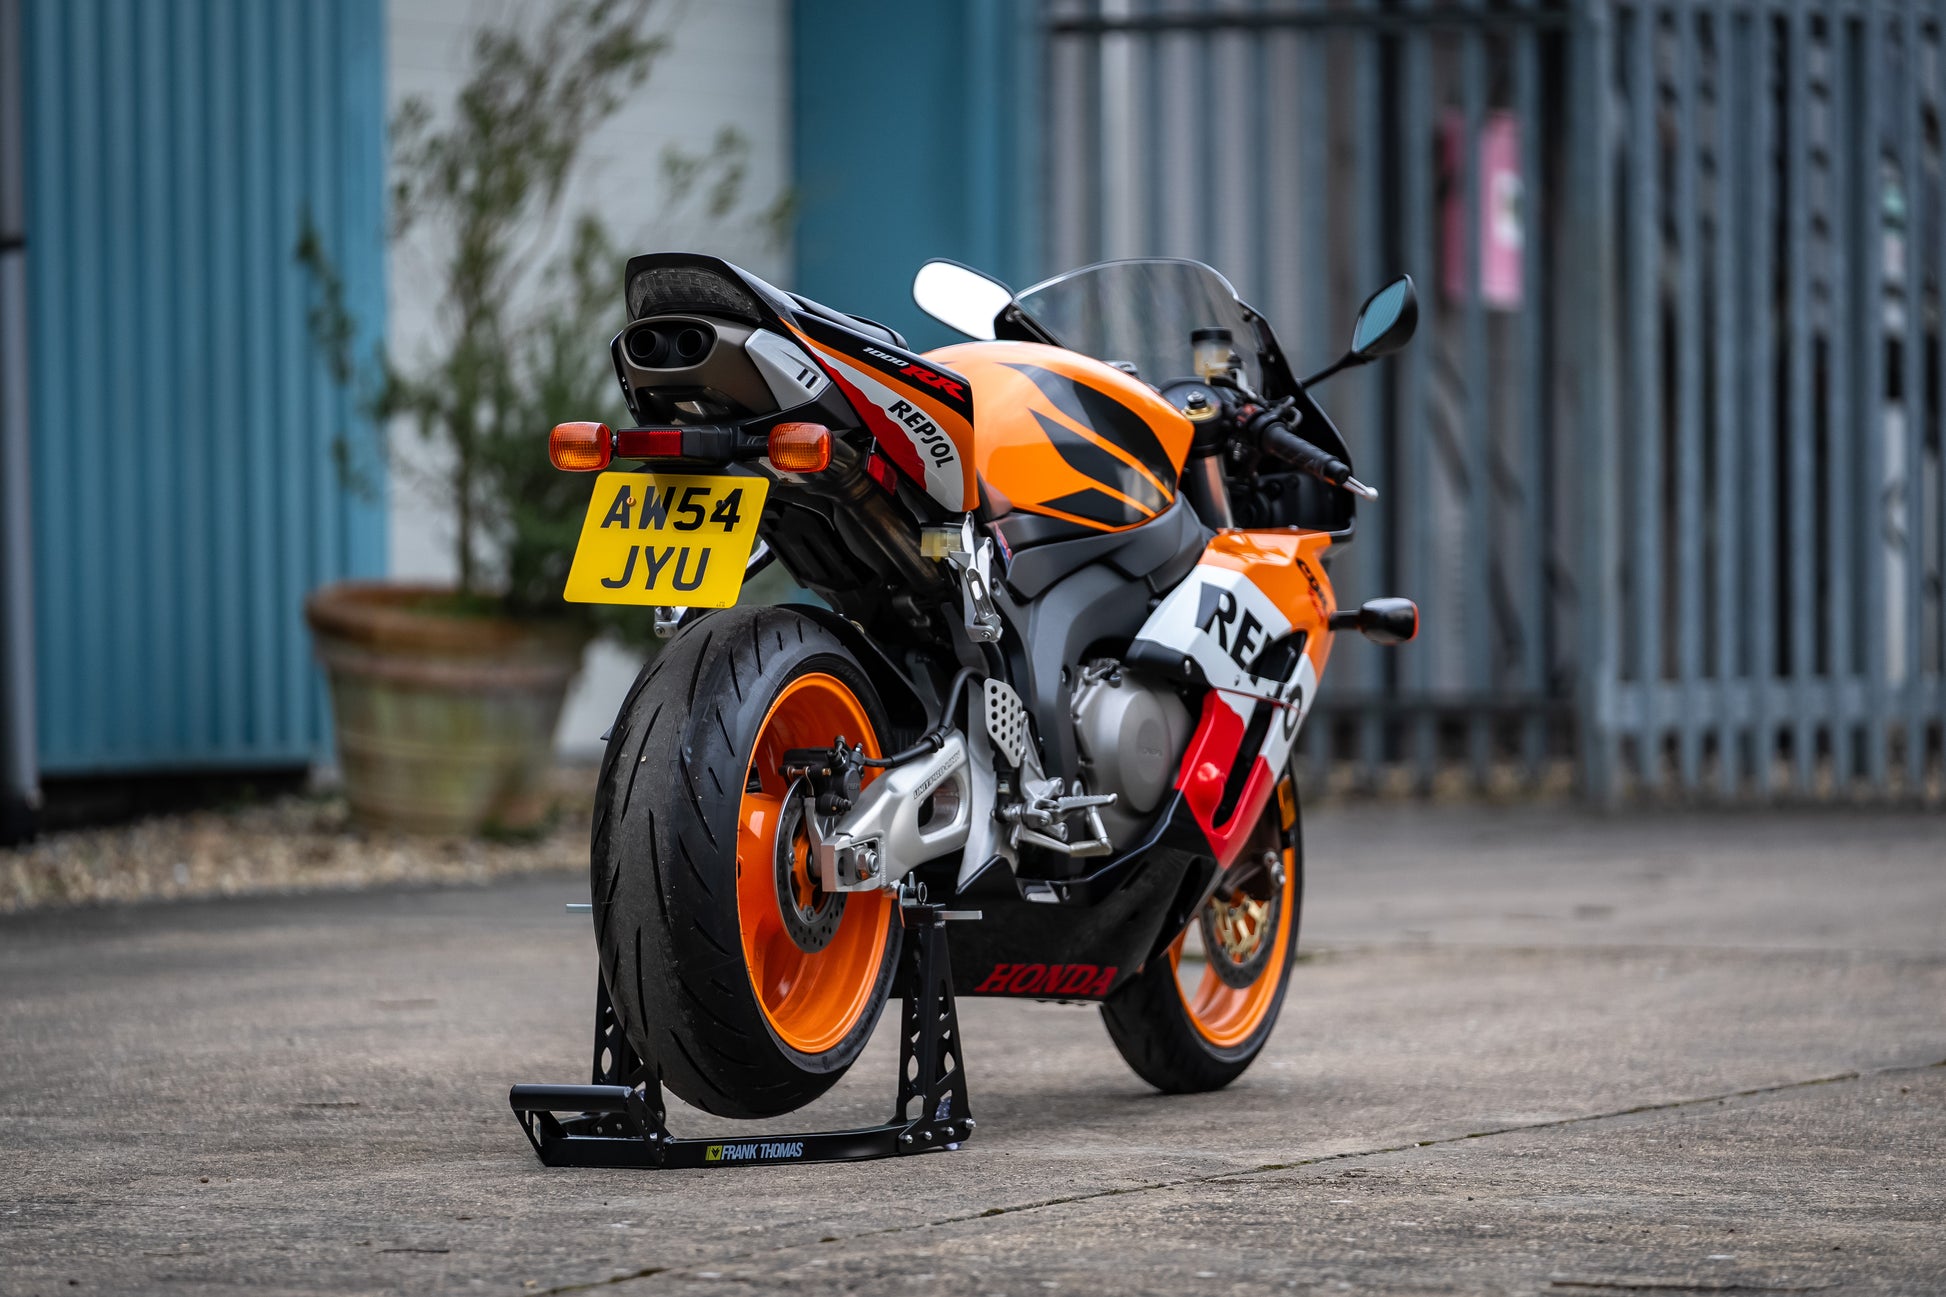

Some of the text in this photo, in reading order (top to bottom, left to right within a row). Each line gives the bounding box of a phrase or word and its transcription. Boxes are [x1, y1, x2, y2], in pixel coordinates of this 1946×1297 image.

[887, 399, 955, 469] REPSOL
[600, 484, 744, 533] AW54
[600, 545, 712, 592] JYU
[974, 963, 1119, 996] HONDA
[721, 1141, 804, 1161] FRANK THOMAS
